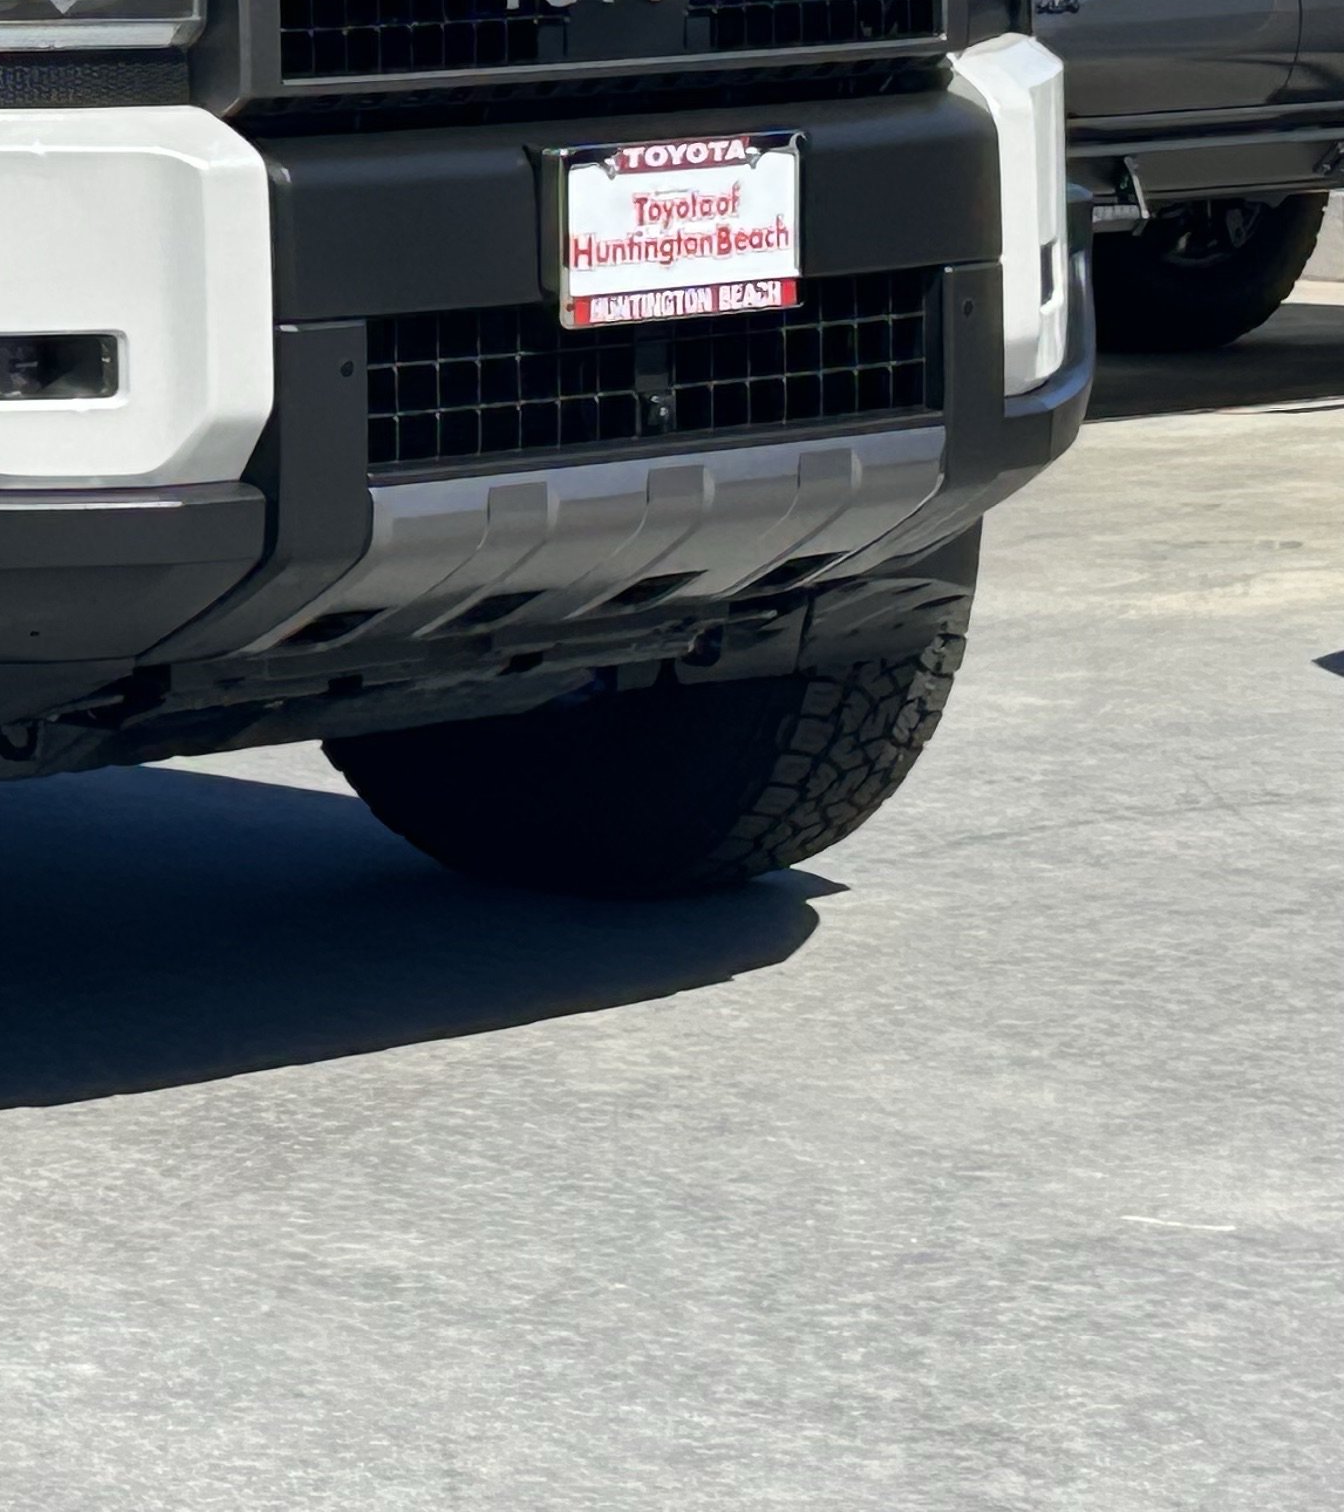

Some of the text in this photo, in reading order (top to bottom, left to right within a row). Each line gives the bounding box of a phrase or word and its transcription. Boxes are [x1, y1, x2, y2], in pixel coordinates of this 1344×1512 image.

[622, 140, 746, 168] TOYOTA
[634, 181, 740, 229] Toyota of
[572, 216, 790, 269] Huntington Beach
[589, 281, 782, 323] HUNTINGTON BEACH
